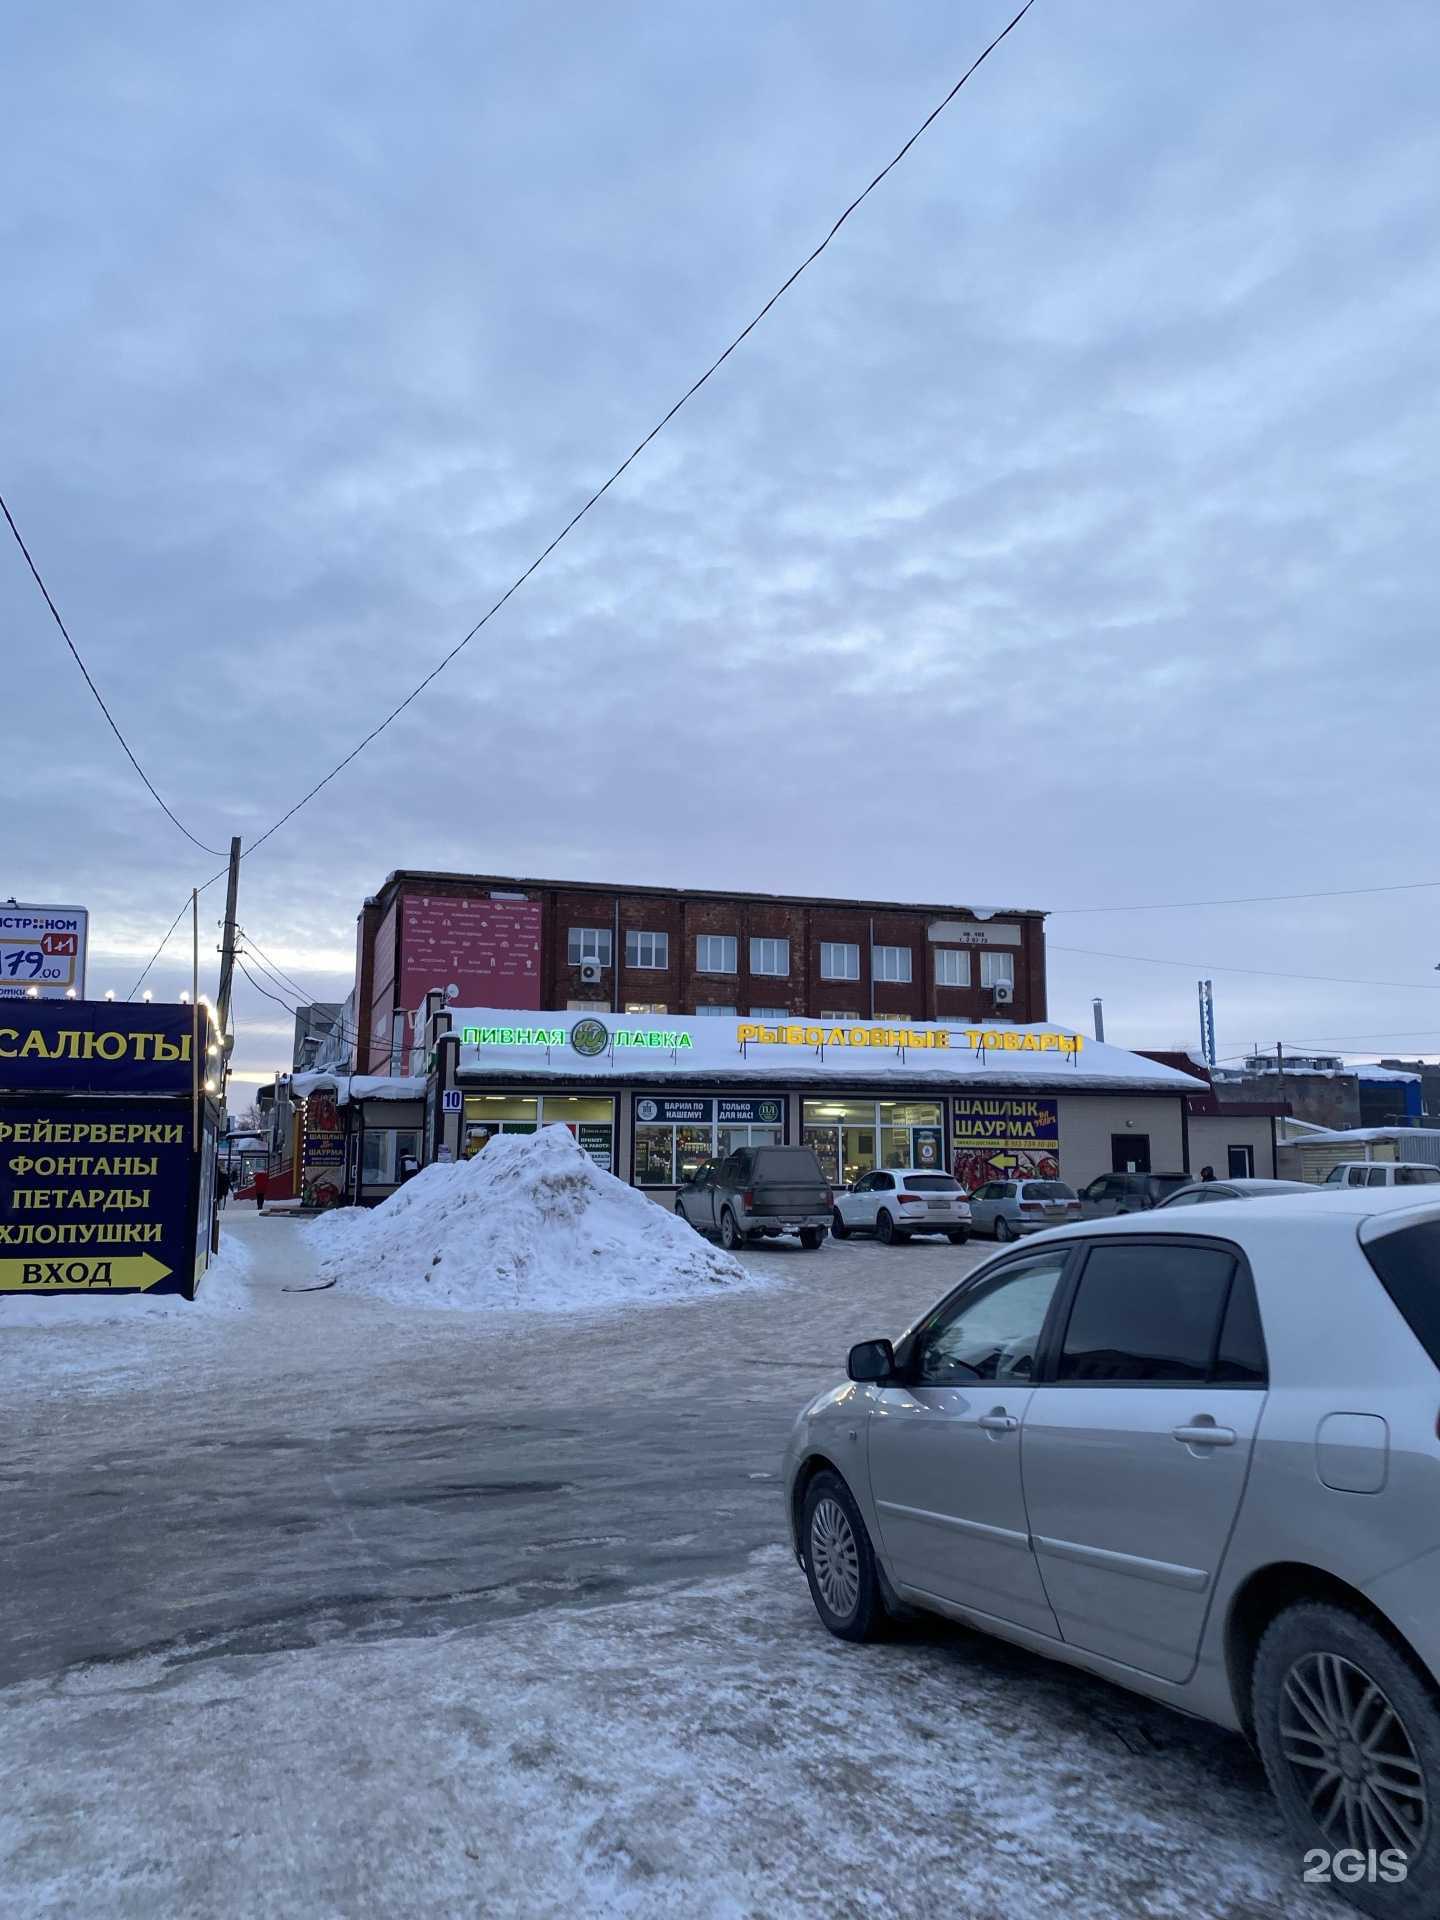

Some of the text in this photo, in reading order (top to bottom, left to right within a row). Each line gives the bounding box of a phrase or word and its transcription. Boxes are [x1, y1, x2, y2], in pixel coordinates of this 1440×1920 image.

[43, 936, 74, 953] 1+1
[0, 1029, 192, 1062] САЛЮТЫ
[462, 1026, 566, 1046] ПИВНАЯ
[615, 1030, 693, 1049] ЛАВКА
[736, 1023, 1085, 1053] РЫБОЛОВНЫЕ ТОВАРЫ
[444, 1092, 460, 1108] 10
[664, 1102, 692, 1110] ВАРИМ
[722, 1103, 751, 1111] ТОЛЬКО
[954, 1100, 1038, 1116] ШАШЛЫК
[719, 1111, 736, 1119] ДЛЯ
[955, 1120, 1037, 1137] ШАУРМА
[8, 1155, 160, 1176] ФОНТАНЫ
[12, 1189, 151, 1213] ПЕТАРДЫ
[0, 1223, 163, 1244] ХЛОПУШКИ
[22, 1262, 112, 1287] ВХОД
